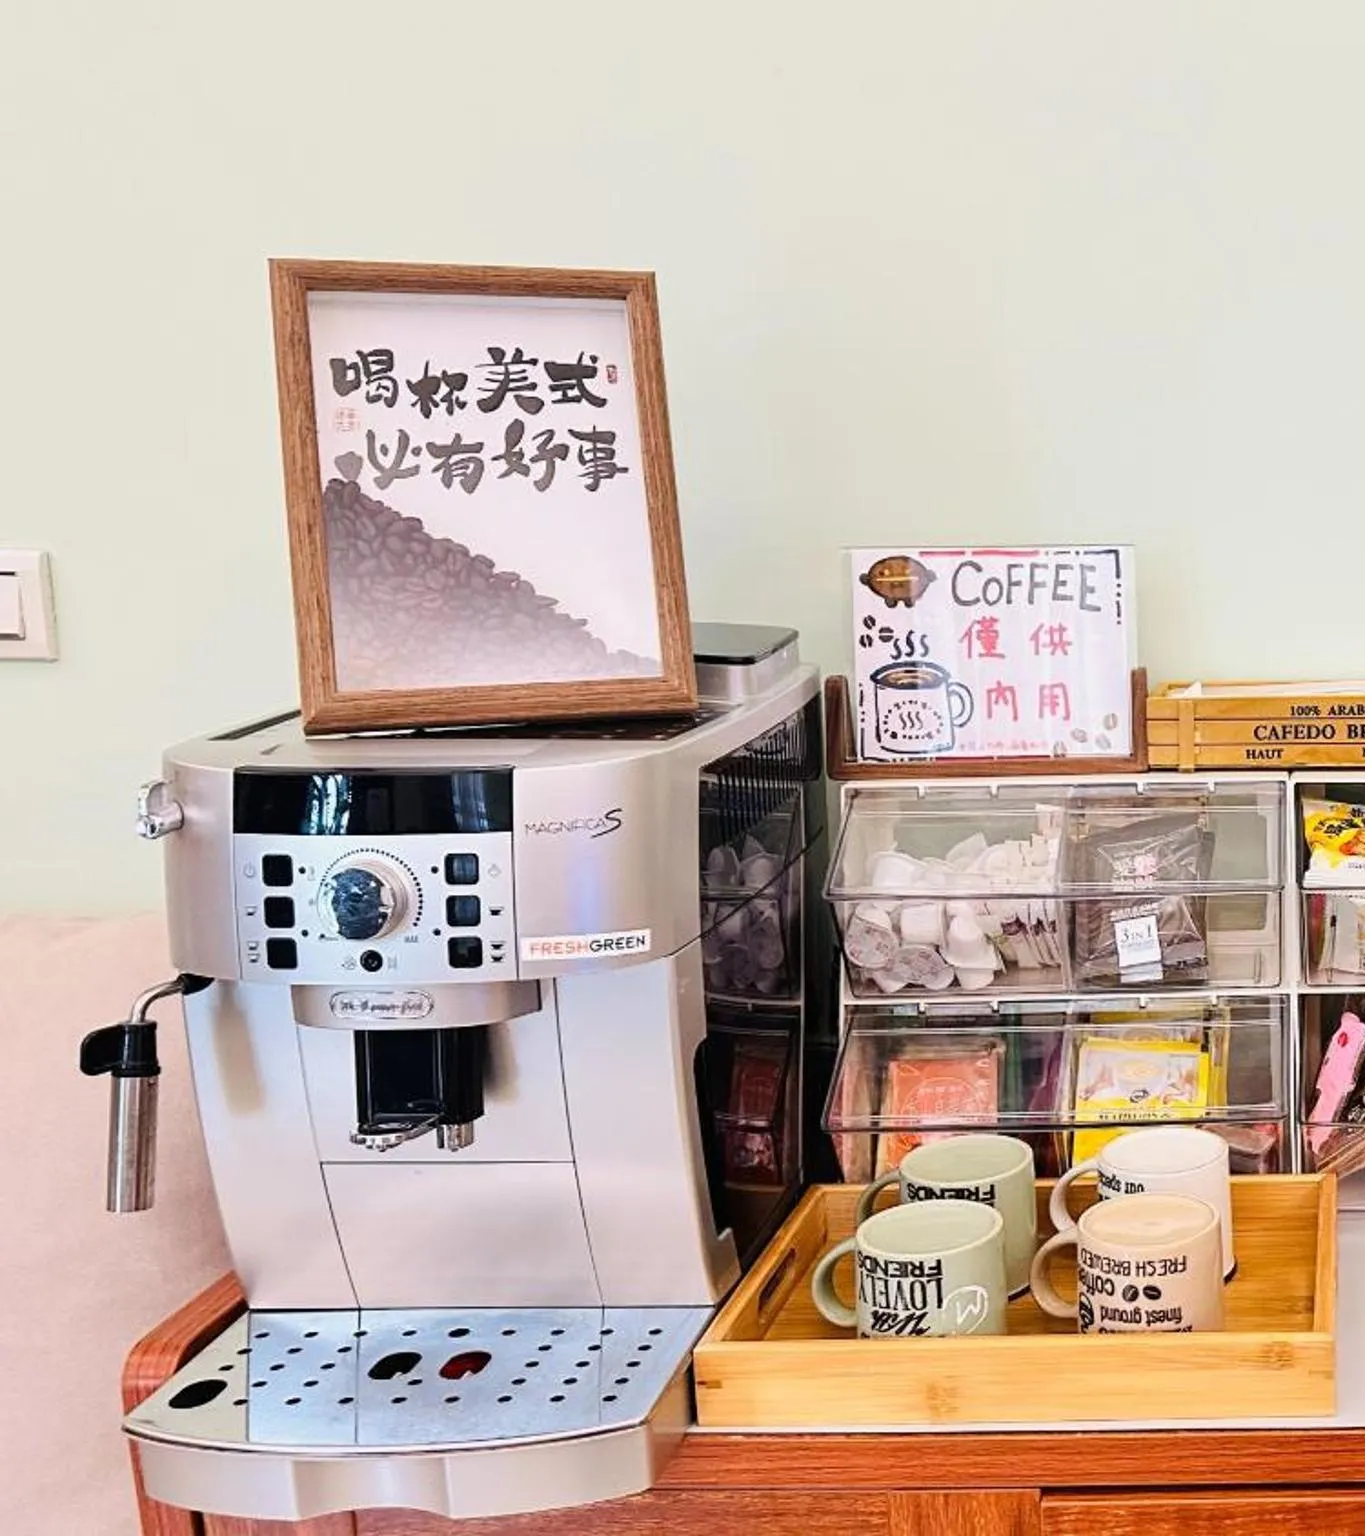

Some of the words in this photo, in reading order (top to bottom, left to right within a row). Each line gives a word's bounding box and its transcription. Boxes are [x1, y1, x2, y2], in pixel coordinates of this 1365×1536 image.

[330, 347, 607, 419] 喝杯美式
[366, 419, 629, 495] 必有好事
[1290, 706, 1321, 716] 100%
[1254, 724, 1336, 741] CAFEDO
[1246, 749, 1284, 760] HAUT
[907, 1183, 995, 1201] FRIENDS
[858, 1251, 943, 1279] FRIENDS
[1136, 1255, 1187, 1277] FRESH
[858, 1270, 943, 1311] LOVELY
[1100, 1306, 1142, 1325] ground
[1145, 1306, 1183, 1327] finest
